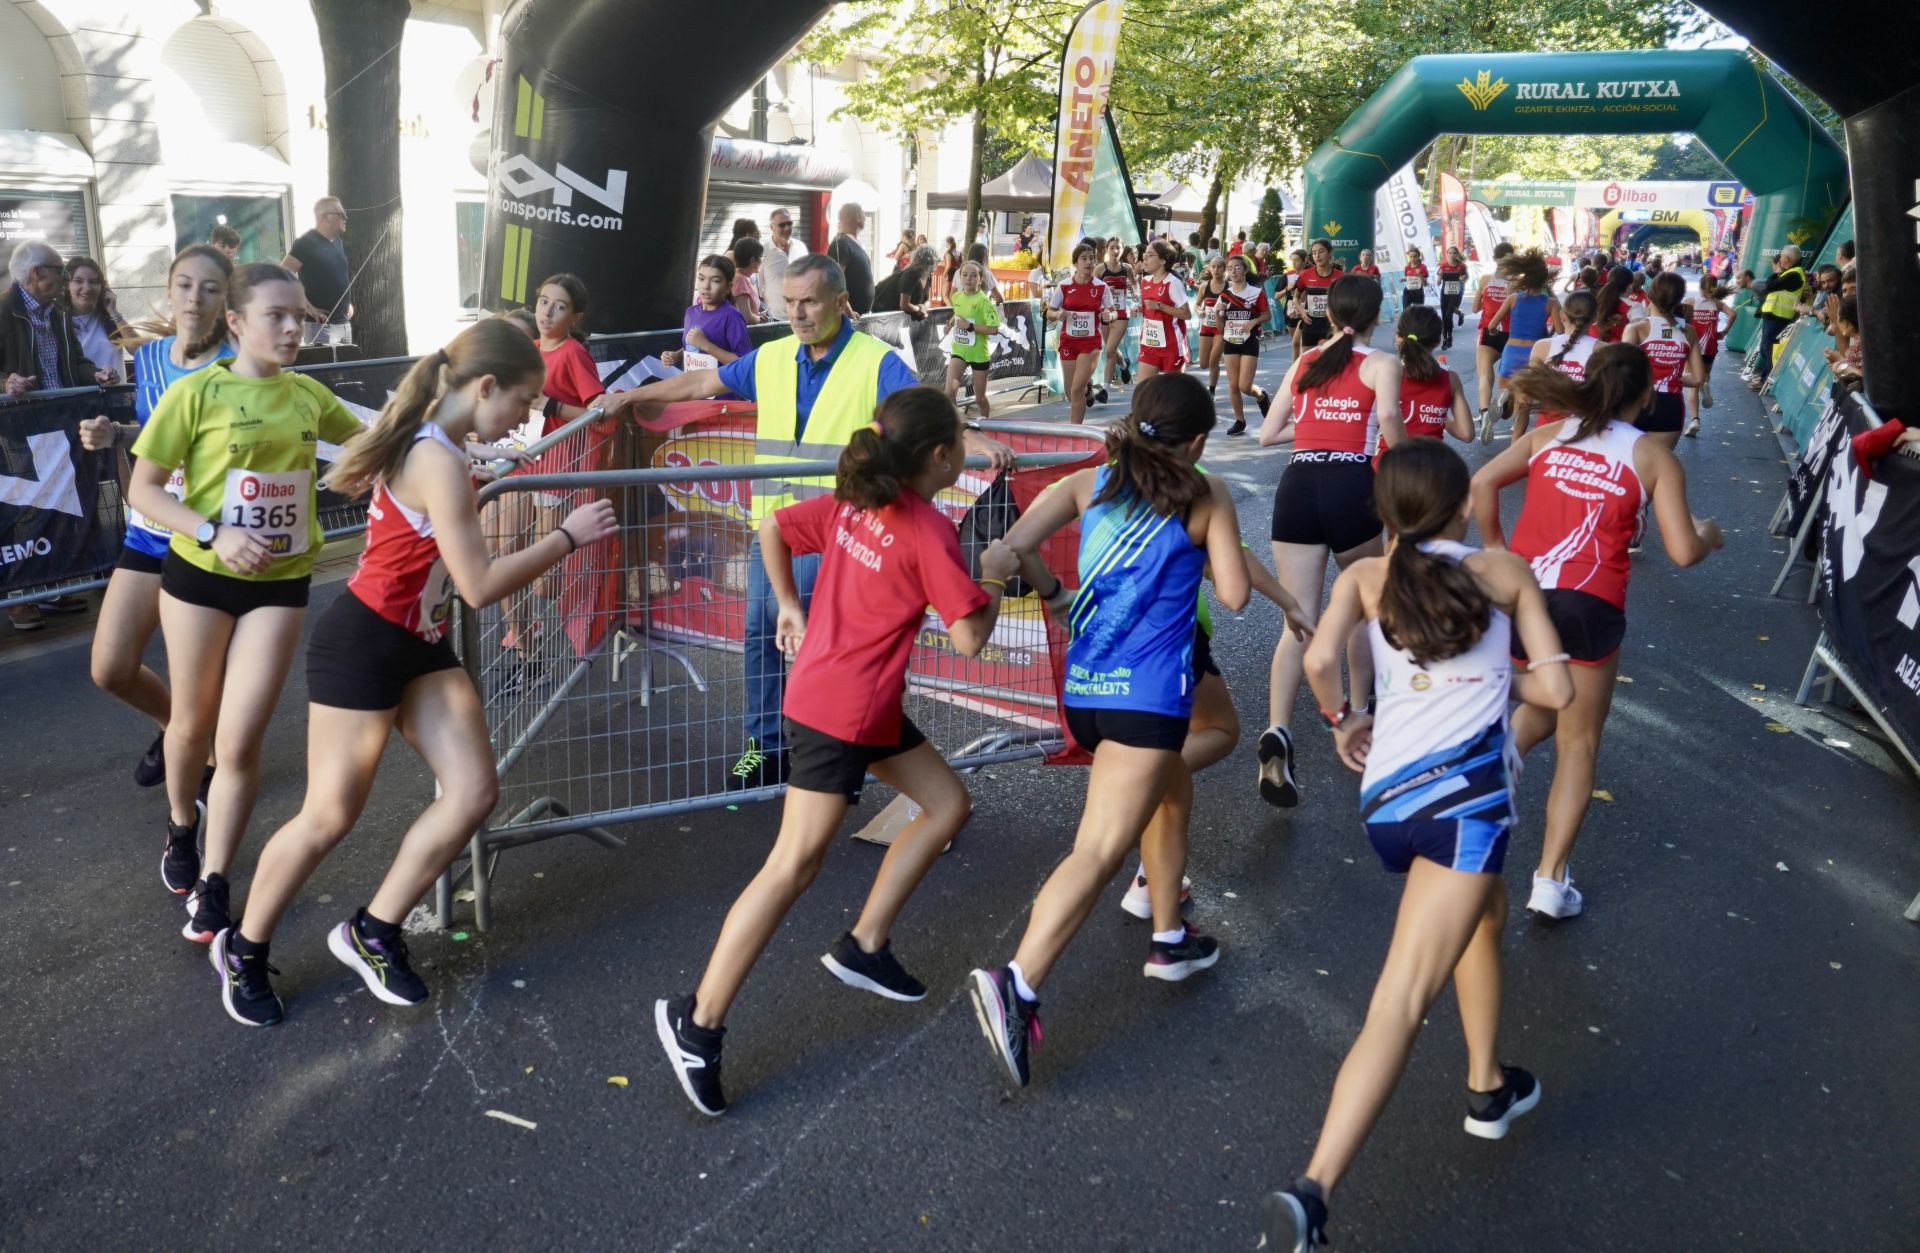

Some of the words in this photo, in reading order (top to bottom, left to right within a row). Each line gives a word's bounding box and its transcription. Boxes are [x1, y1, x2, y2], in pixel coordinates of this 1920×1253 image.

[1516, 83, 1590, 100] RURAL
[1596, 80, 1680, 99] KUTXA
[1556, 105, 1595, 113] EKINTZA
[1602, 104, 1640, 112] ACCIÓN
[1643, 104, 1679, 112] SOCIAL
[1061, 56, 1095, 193] ANETO
[1505, 190, 1532, 198] RURAL
[1534, 190, 1565, 198] KUTXA
[1603, 183, 1657, 206] Bilbao
[1650, 210, 1680, 223] BM
[1331, 239, 1359, 247] KUTXA
[1072, 320, 1089, 329] 450
[1647, 343, 1680, 351] Bilbao
[1314, 397, 1360, 409] Colegio
[1314, 409, 1362, 423] Vizcaya
[1328, 451, 1367, 463] PRO
[1544, 450, 1608, 474] Bilbao
[1543, 464, 1627, 496] Atletismo
[240, 476, 296, 502] Bilbao
[231, 503, 297, 529] 1365
[0, 537, 52, 565] EMO
